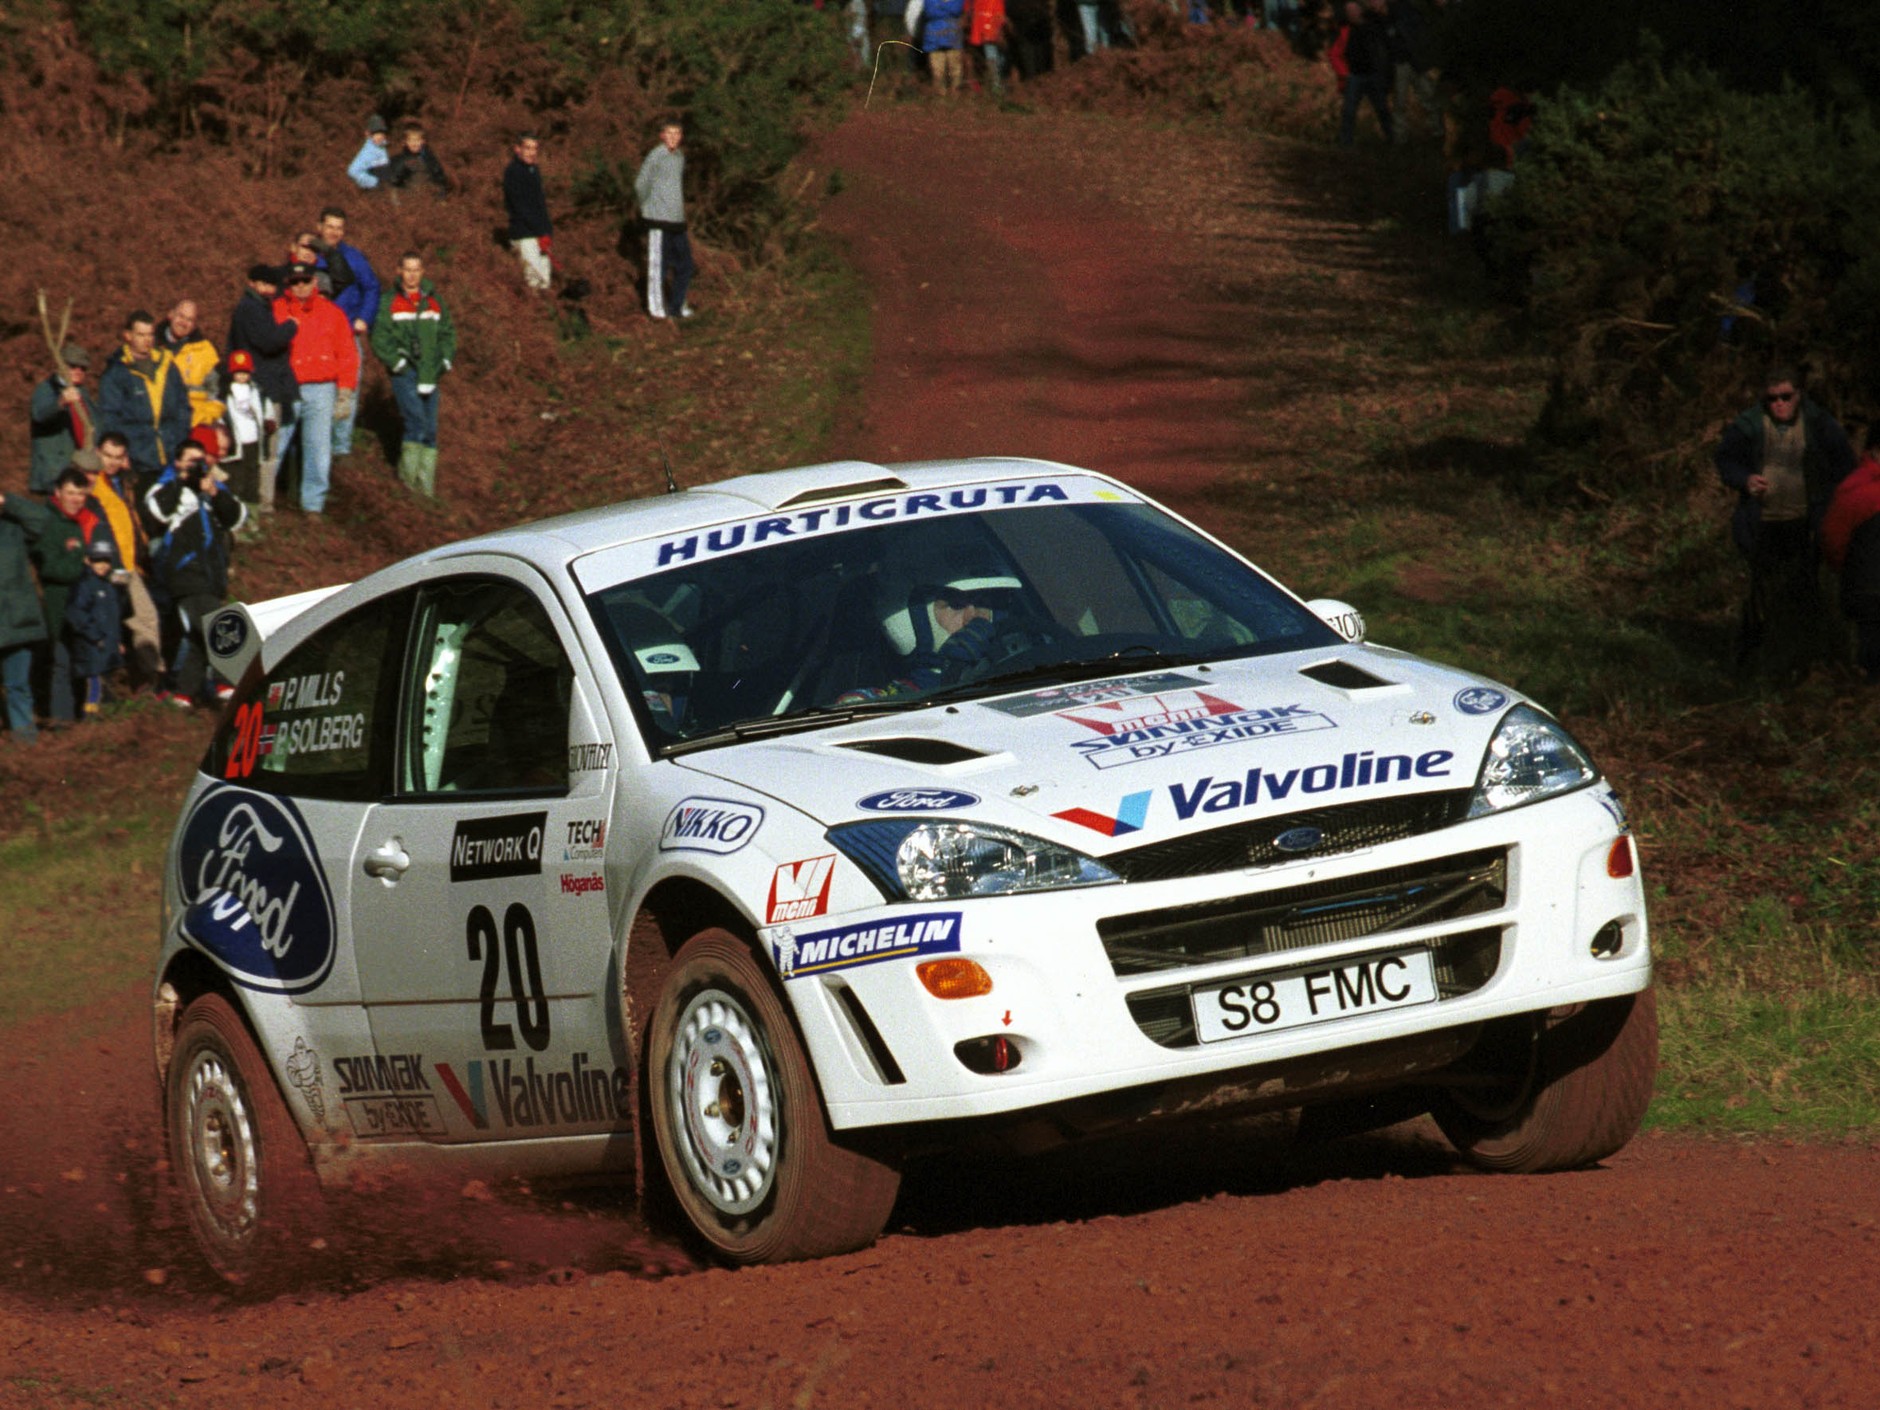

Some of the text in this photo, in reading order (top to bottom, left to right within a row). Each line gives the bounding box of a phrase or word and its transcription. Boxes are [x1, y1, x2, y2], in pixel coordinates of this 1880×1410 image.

[656, 484, 1068, 567] HURTIGRUTA
[295, 670, 345, 709] MILLS
[225, 701, 263, 778] 20
[288, 712, 365, 755] SOLBERG
[1129, 721, 1298, 758] by EXIDE
[877, 791, 957, 808] Ford
[1168, 750, 1455, 820] Valvoline
[527, 826, 541, 860] Q
[567, 819, 602, 845] TECH
[665, 807, 752, 842] NIKKO
[199, 803, 299, 958] Ford
[560, 871, 605, 897] Höganäs
[800, 918, 956, 966] MICHELIN
[466, 902, 550, 1052] 20
[1217, 956, 1412, 1031] S8 FMC
[488, 1052, 632, 1128] Valvoline
